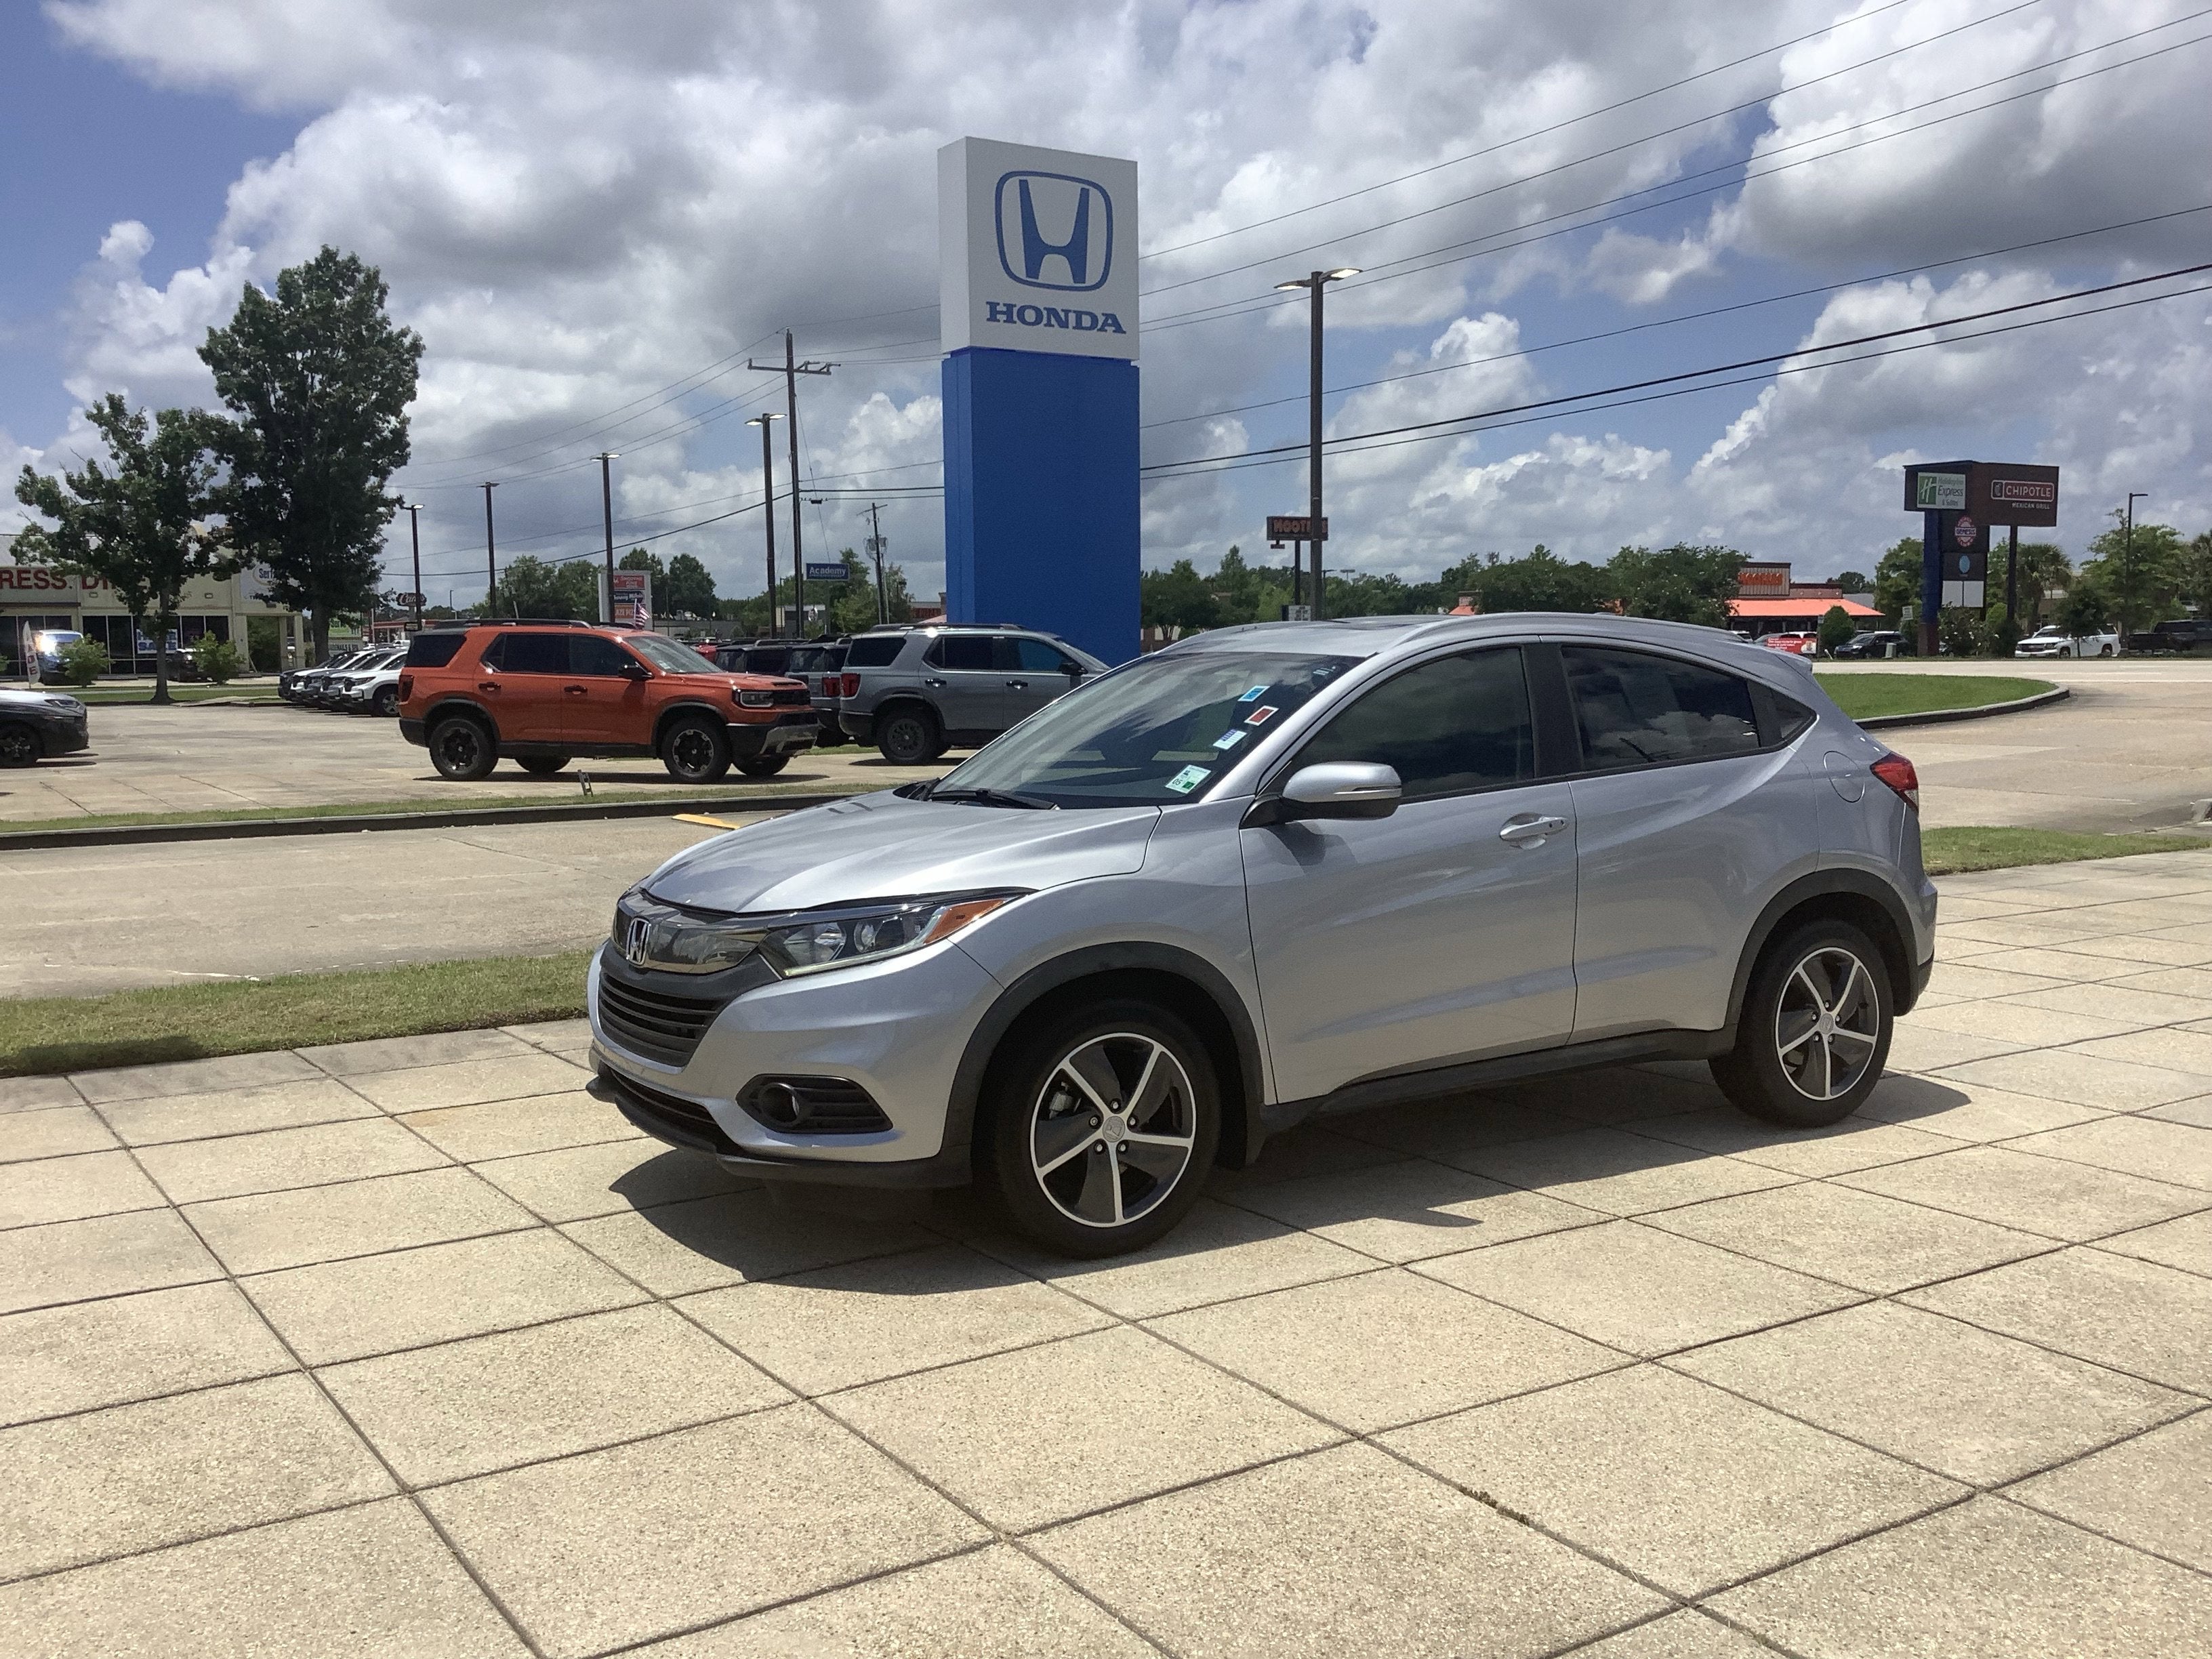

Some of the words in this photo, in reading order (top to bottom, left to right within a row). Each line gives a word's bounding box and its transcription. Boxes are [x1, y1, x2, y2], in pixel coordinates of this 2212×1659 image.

[986, 301, 1126, 334] HONDA
[1938, 485, 1963, 498] Express
[2006, 485, 2051, 497] CHIPOTLE
[809, 565, 846, 577] Academy
